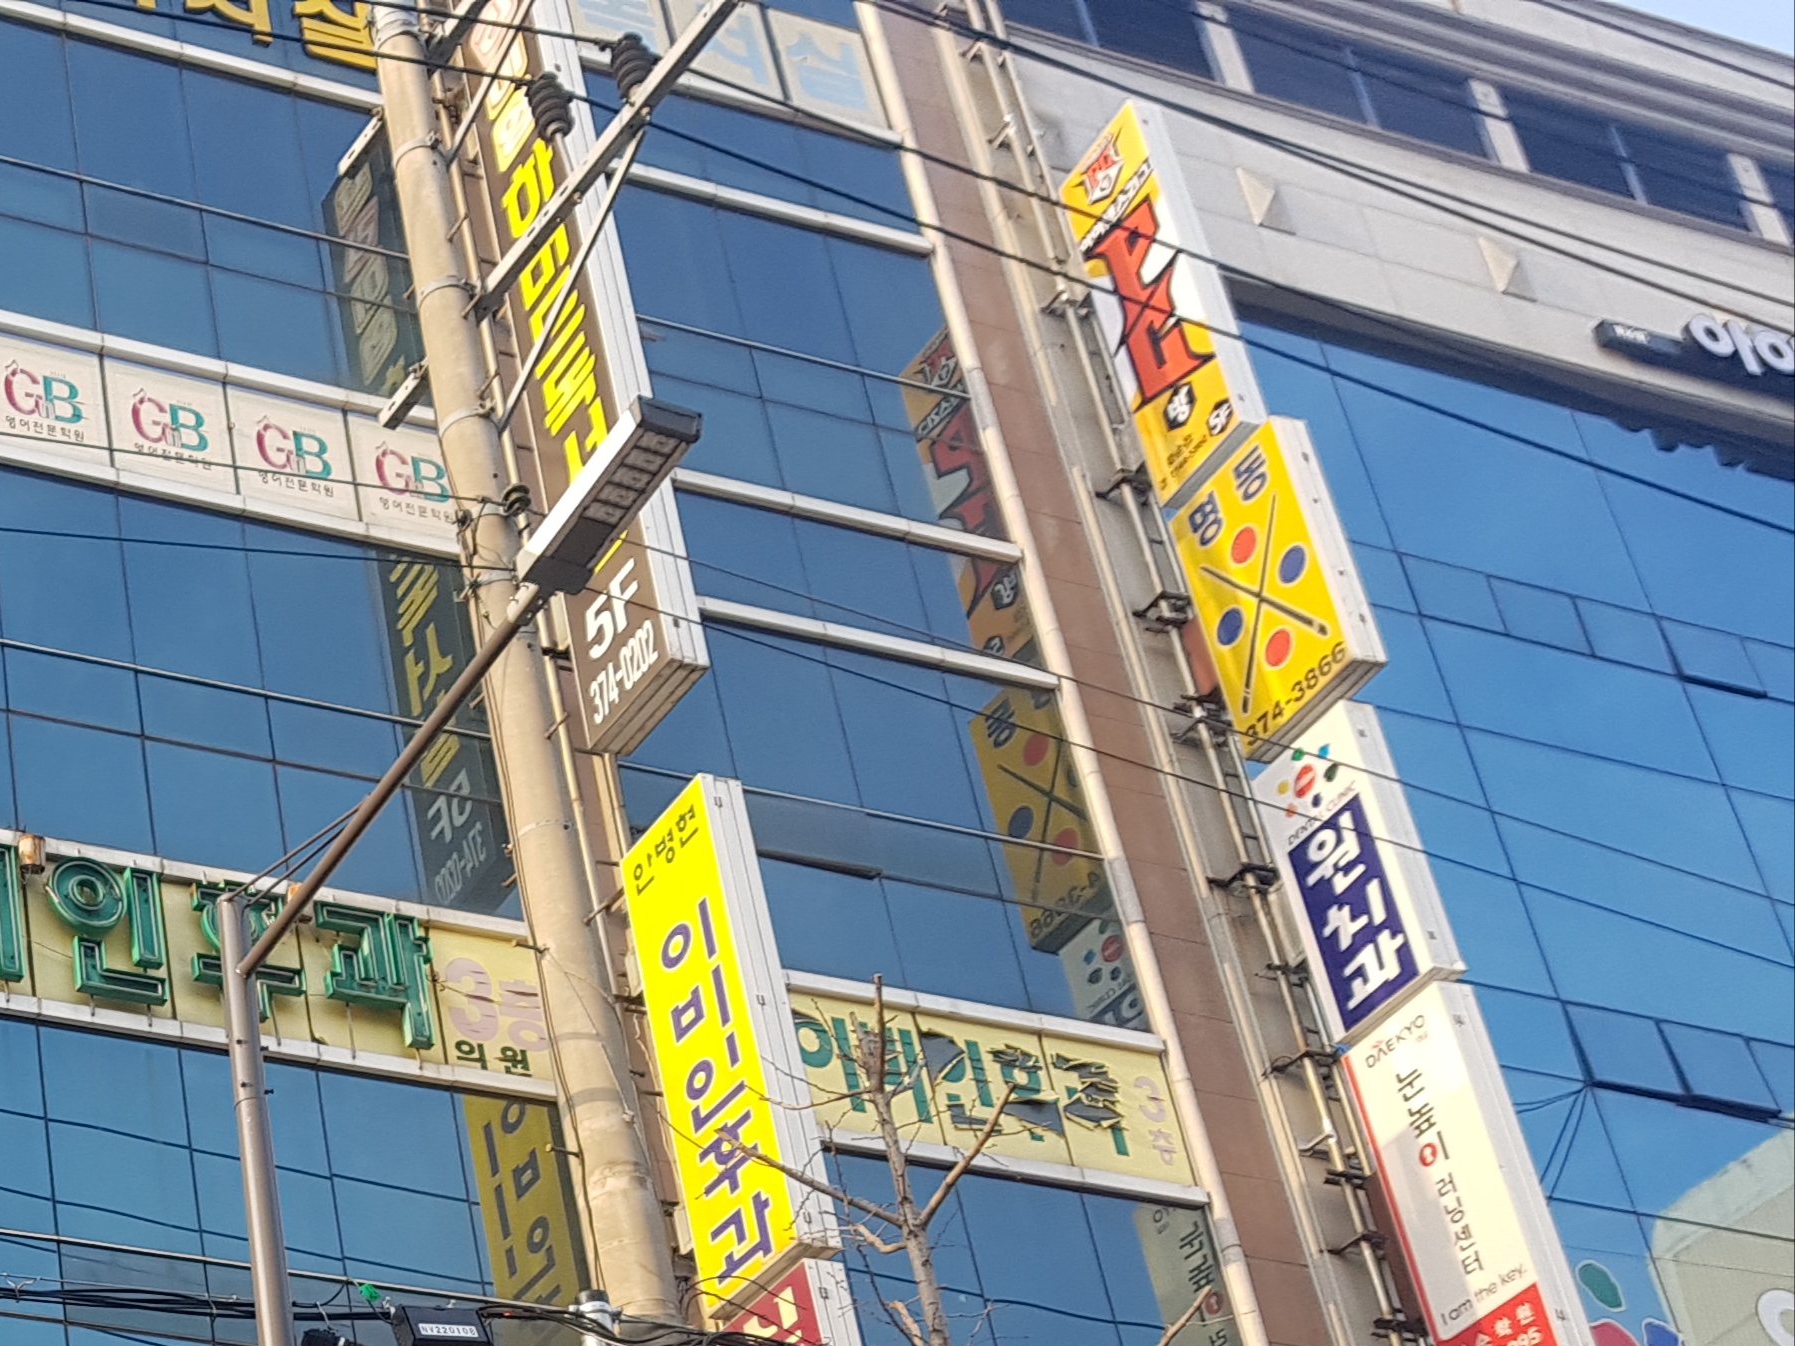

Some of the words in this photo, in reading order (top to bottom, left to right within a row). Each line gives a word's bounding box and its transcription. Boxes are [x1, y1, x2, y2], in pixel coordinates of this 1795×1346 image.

[585, 558, 638, 658] 5F
[590, 620, 658, 724] 374-0202
[1245, 641, 1345, 746] 374-3866
[633, 804, 699, 896] 안병현
[1306, 811, 1405, 1011] 원치과
[455, 1040, 533, 1077] 의원
[660, 897, 773, 1286] 이비인후과
[1366, 1015, 1425, 1069] DAEKYO
[1396, 1068, 1450, 1167] 눈높이
[1436, 1173, 1484, 1275] 러닝센터
